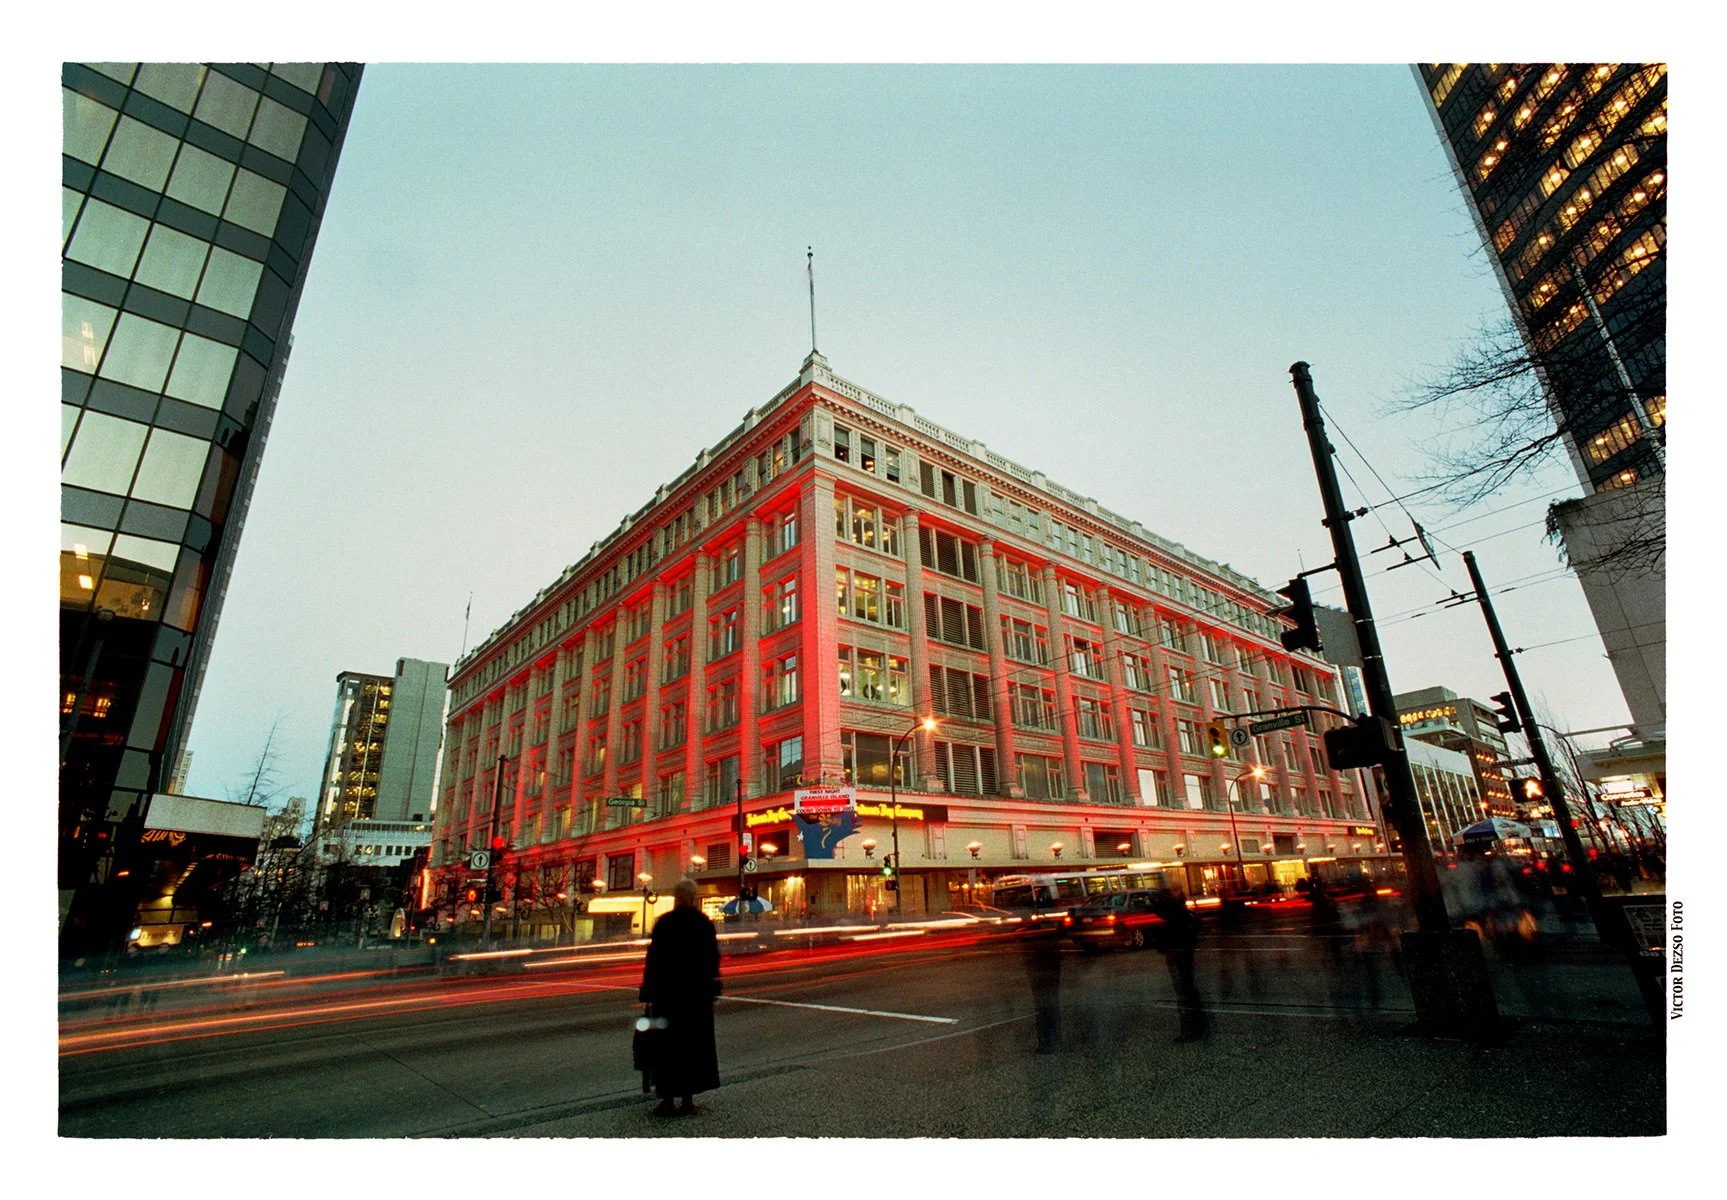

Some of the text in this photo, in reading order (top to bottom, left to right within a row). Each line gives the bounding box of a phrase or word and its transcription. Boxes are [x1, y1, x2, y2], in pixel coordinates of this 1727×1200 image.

[1252, 715, 1305, 733] Granville St
[1600, 791, 1646, 801] Cosmetics
[608, 798, 636, 806] Georgia
